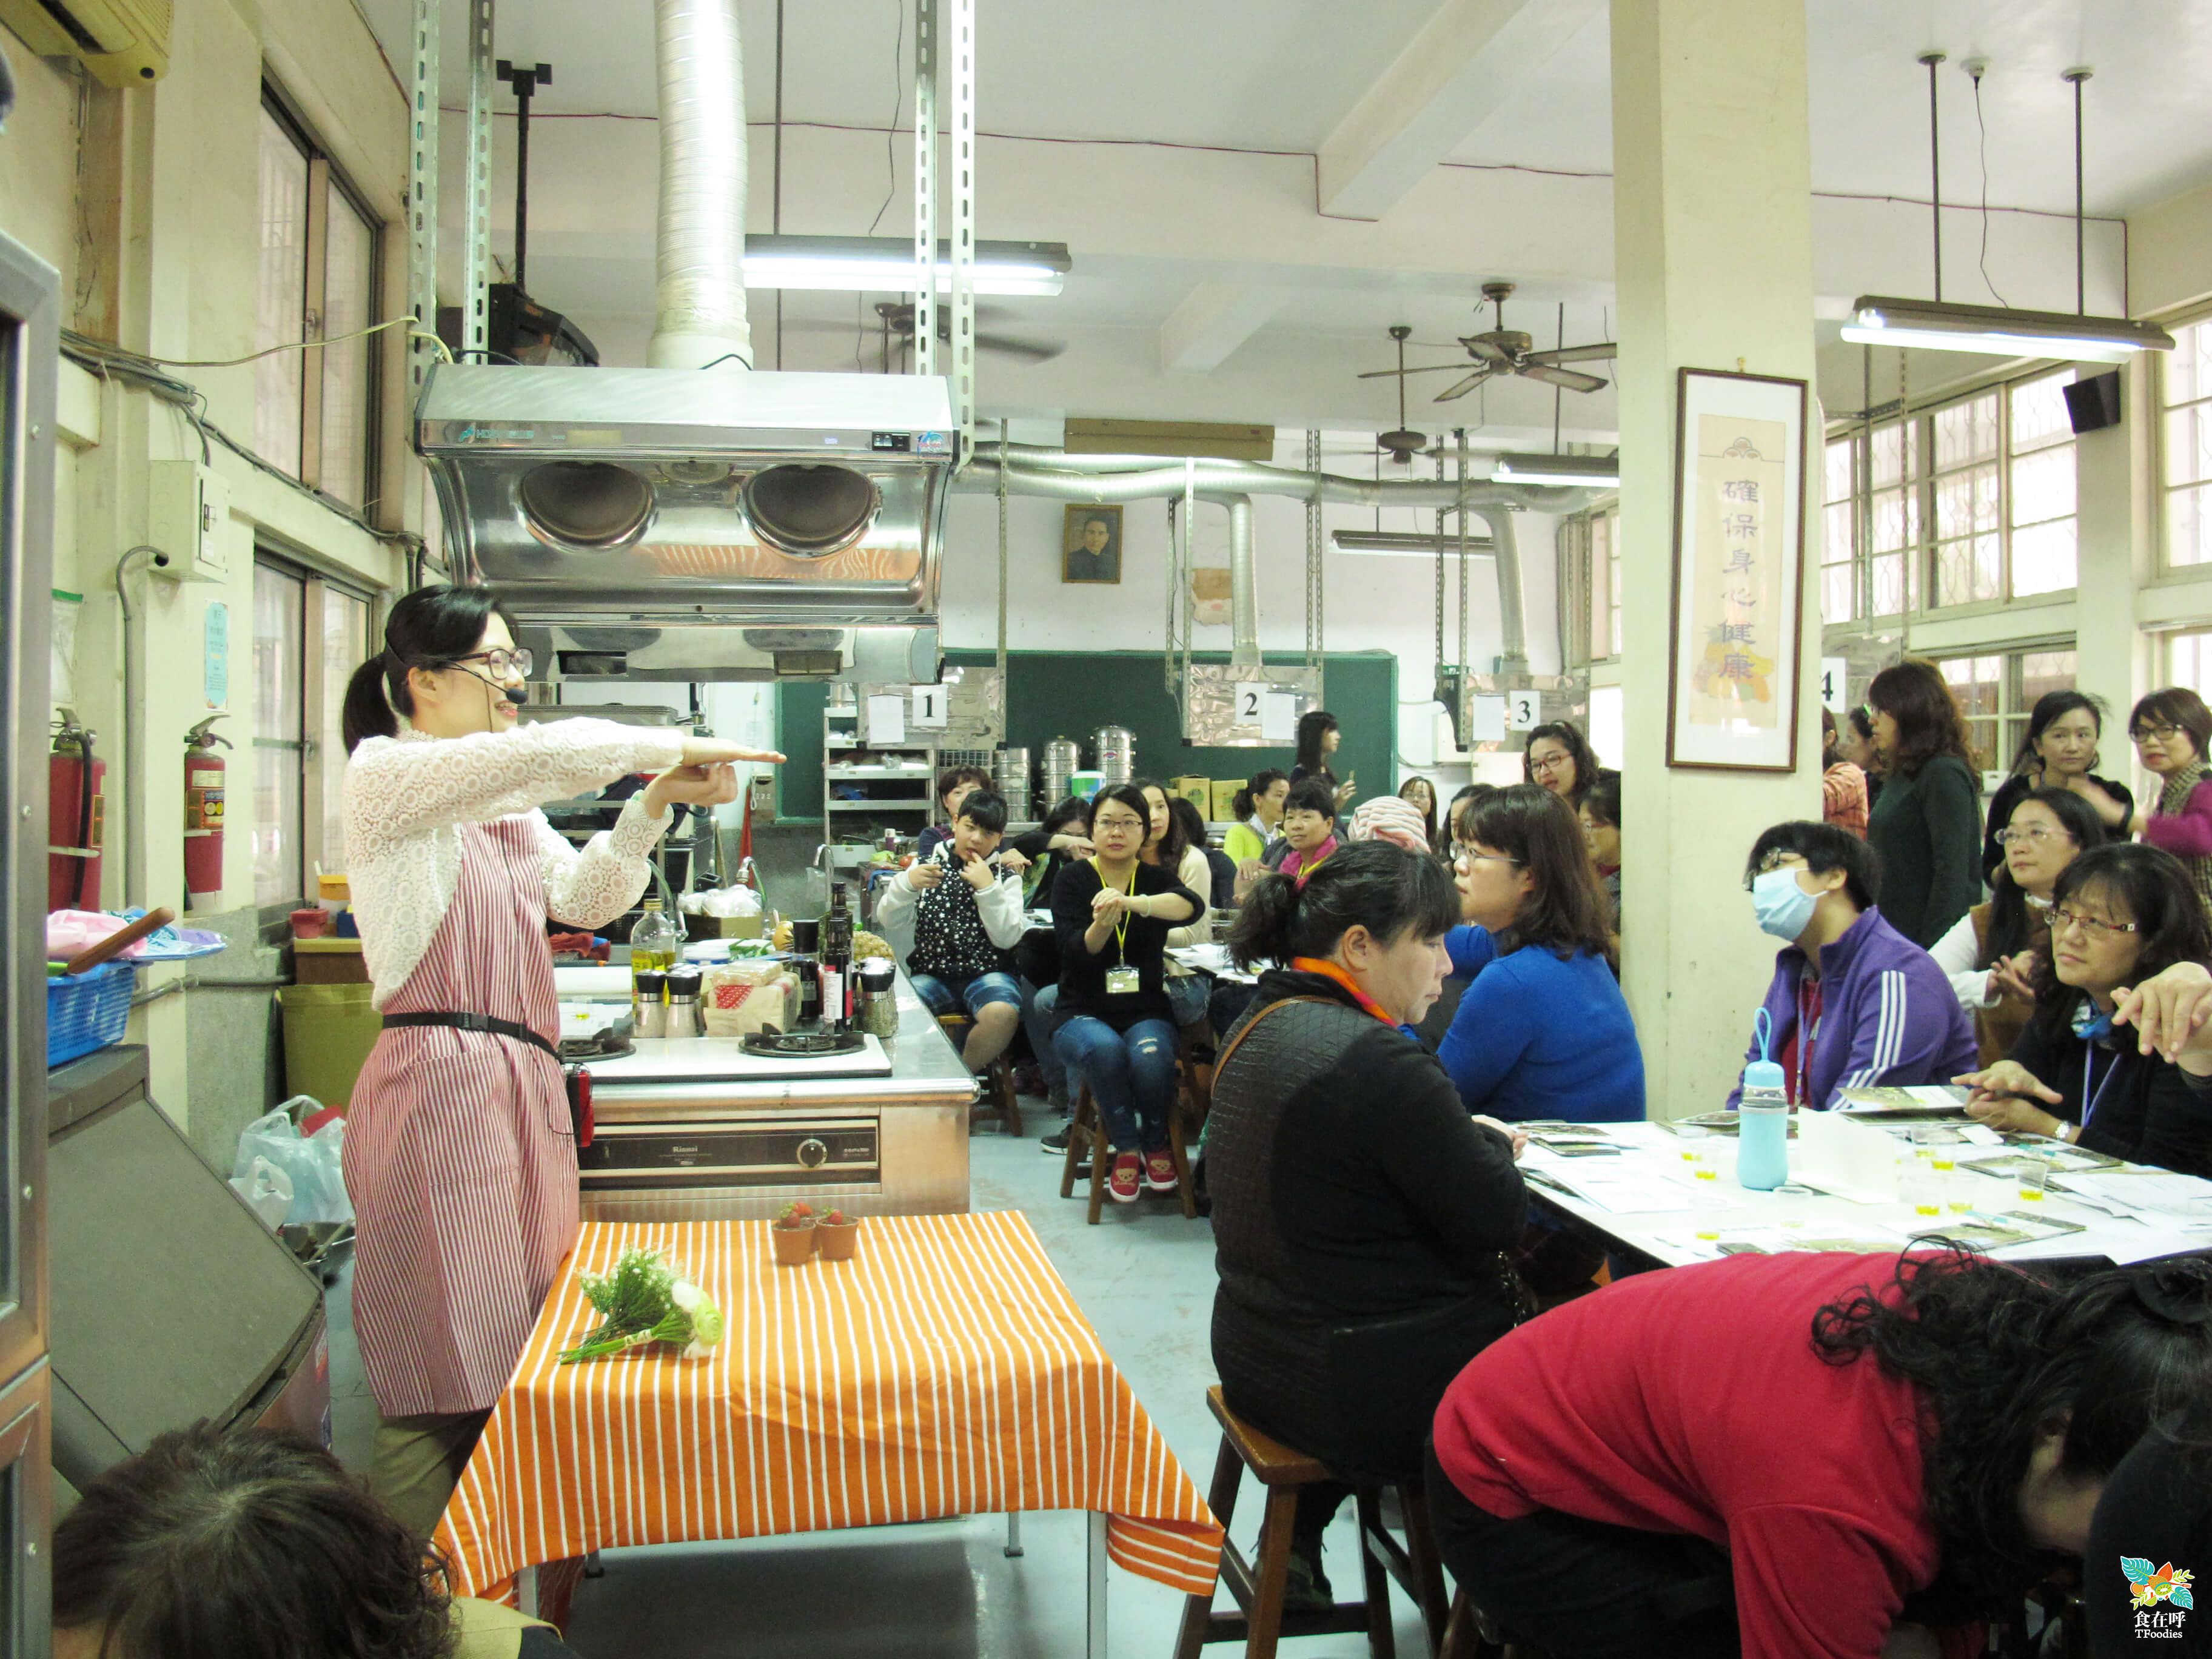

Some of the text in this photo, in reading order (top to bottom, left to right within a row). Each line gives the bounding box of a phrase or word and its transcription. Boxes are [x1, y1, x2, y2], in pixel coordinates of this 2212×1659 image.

[1718, 479, 1760, 680] 確保身心健康
[1820, 671, 1834, 702] 4
[922, 693, 936, 718] 1
[1244, 691, 1259, 717] 2
[1517, 700, 1532, 724] 3
